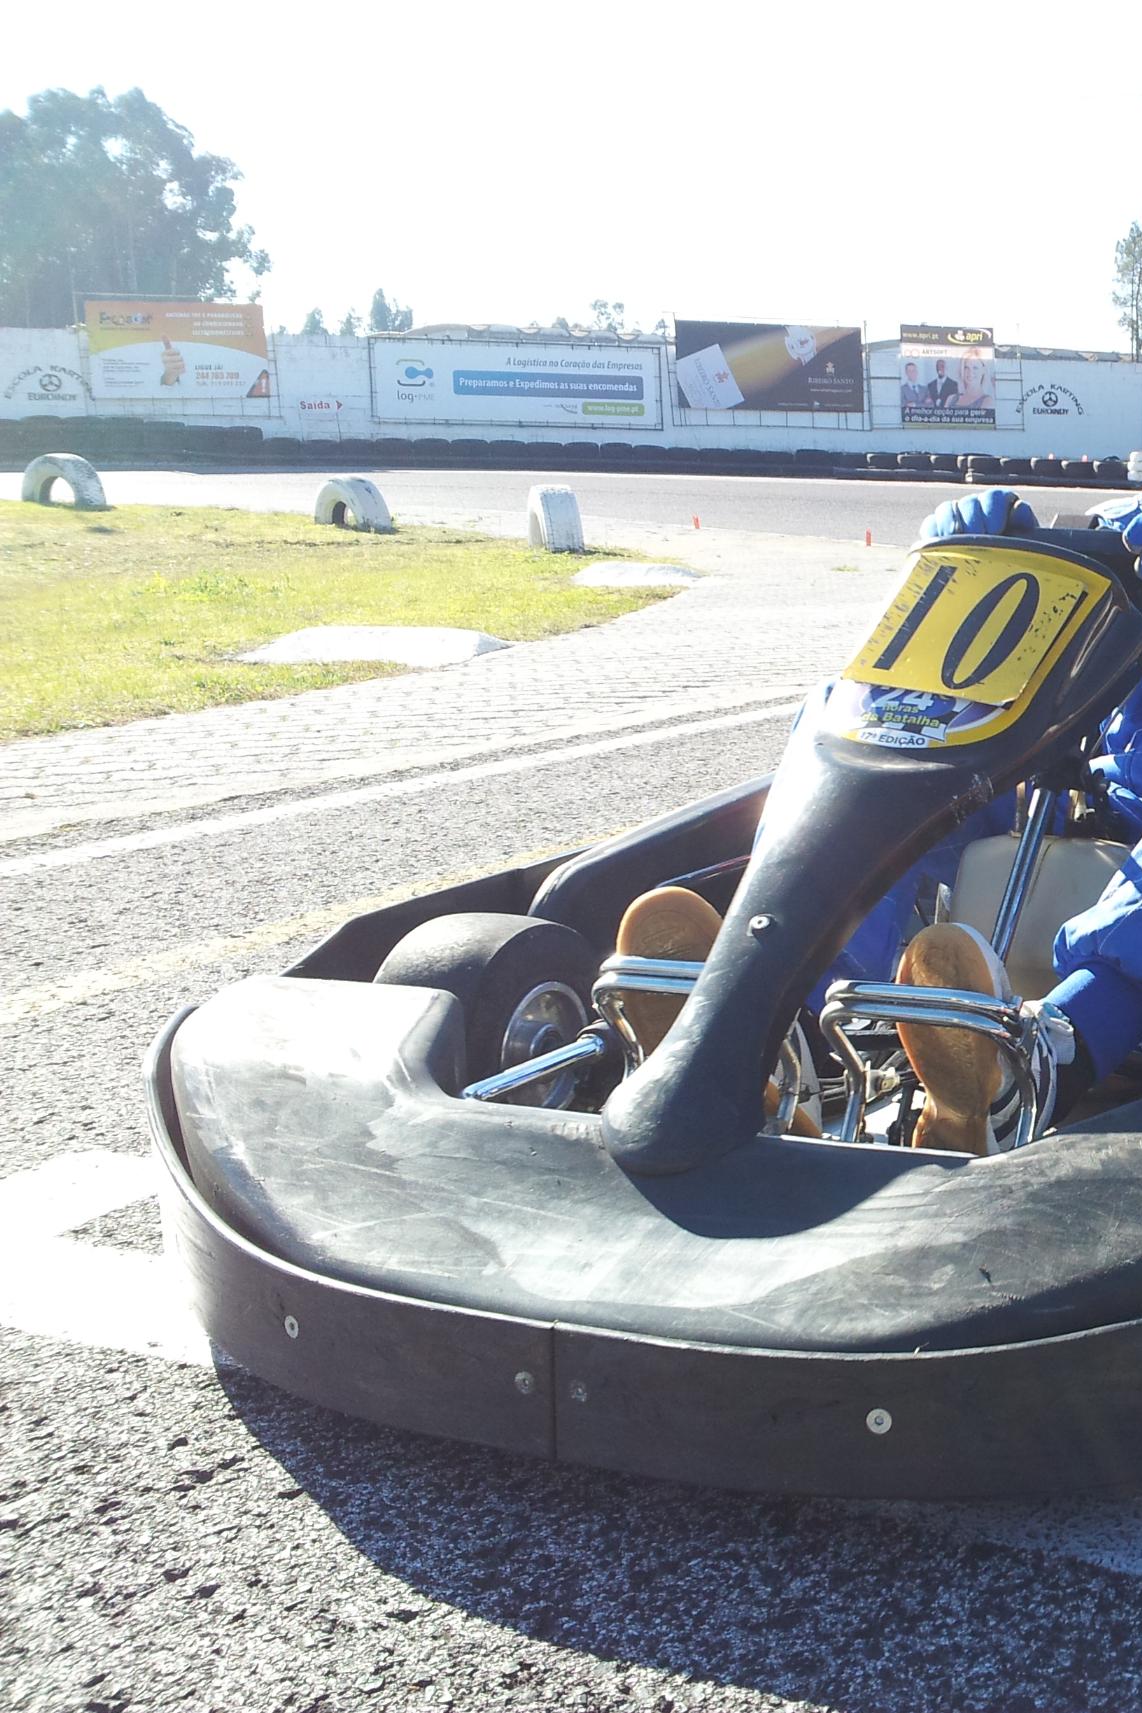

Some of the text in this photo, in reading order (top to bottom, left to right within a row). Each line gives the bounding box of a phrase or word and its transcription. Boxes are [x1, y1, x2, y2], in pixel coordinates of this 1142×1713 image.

[965, 331, 983, 343] apri
[592, 360, 605, 369] das
[607, 360, 643, 371] Empresas
[459, 377, 507, 389] Preparamos
[516, 378, 558, 390] Expedimos
[570, 382, 587, 390] suas
[588, 382, 637, 392] encomendas
[911, 407, 933, 415] melhor
[872, 564, 1041, 690] 10
[882, 711, 941, 728] Batalha
[878, 733, 926, 747] EDIÇÃO
